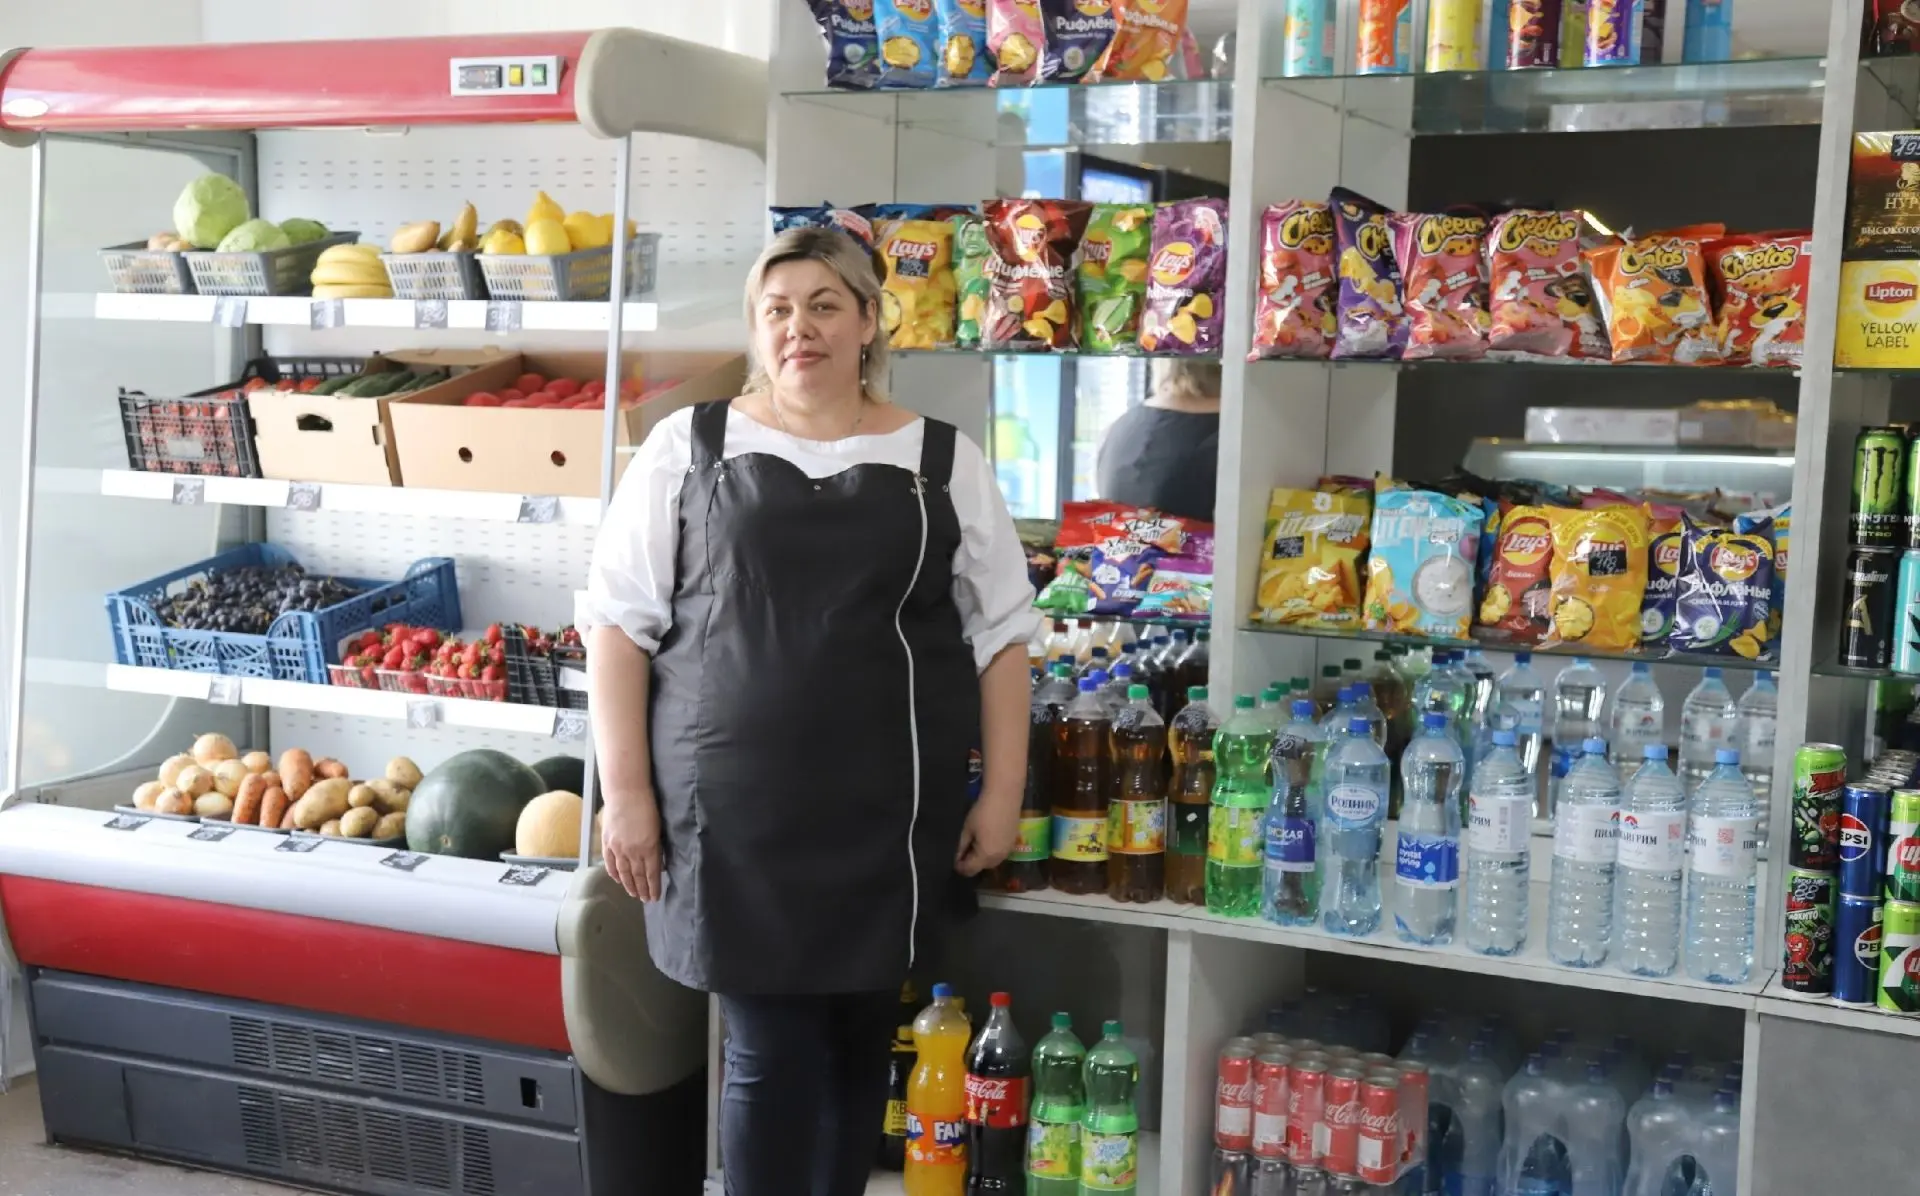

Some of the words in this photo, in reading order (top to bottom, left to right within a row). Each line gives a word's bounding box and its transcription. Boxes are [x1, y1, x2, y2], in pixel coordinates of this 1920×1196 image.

[1884, 197, 1920, 210] НУР
[1419, 215, 1486, 253] Chee
[1500, 214, 1576, 250] Cheetos
[1861, 226, 1920, 236] ВЫСОКОГО
[1621, 248, 1683, 273] Cetos
[1722, 248, 1794, 280] Cheetos
[1868, 285, 1913, 300] Lipton
[1860, 322, 1918, 335] YELLOW
[1866, 336, 1909, 349] LABEL
[1852, 511, 1899, 524] ONSTE
[965, 1079, 1010, 1100] oca-Cola
